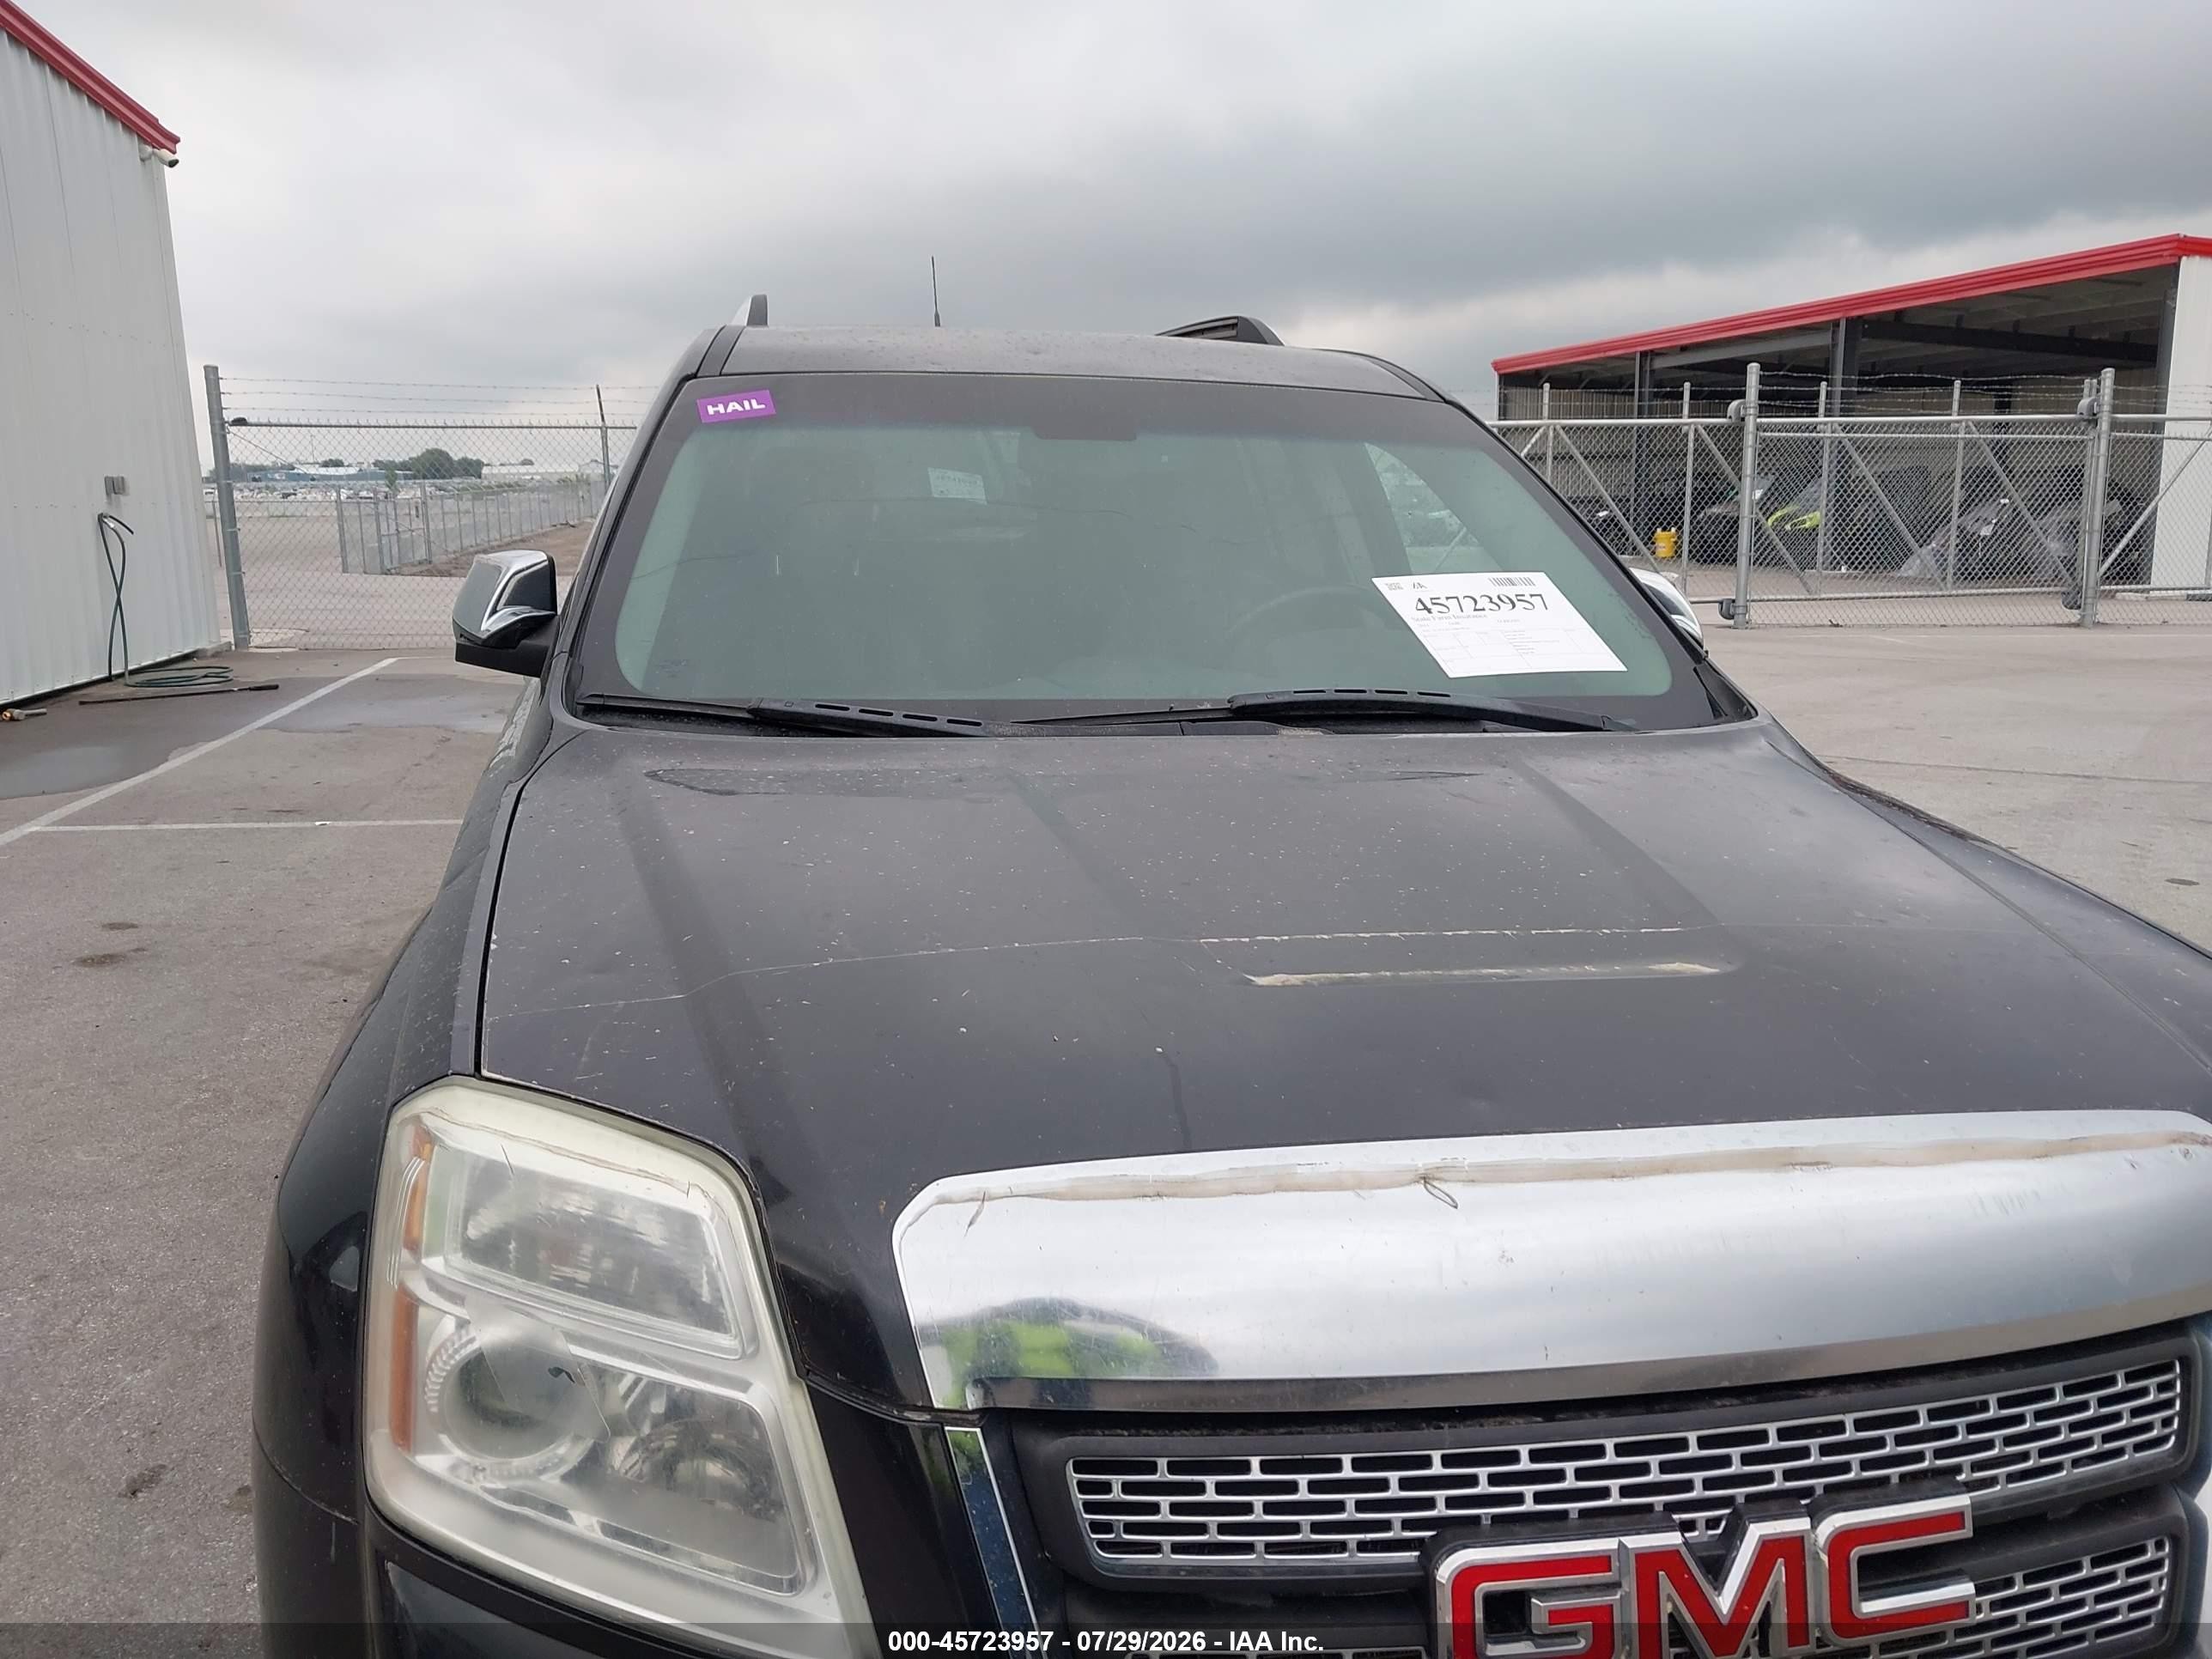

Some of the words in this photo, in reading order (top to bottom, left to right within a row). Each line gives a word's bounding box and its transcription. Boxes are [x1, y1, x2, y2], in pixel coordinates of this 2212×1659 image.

[707, 398, 766, 416] HAIL
[1416, 594, 1548, 614] 45723957
[1435, 1494, 1975, 1659] GMC
